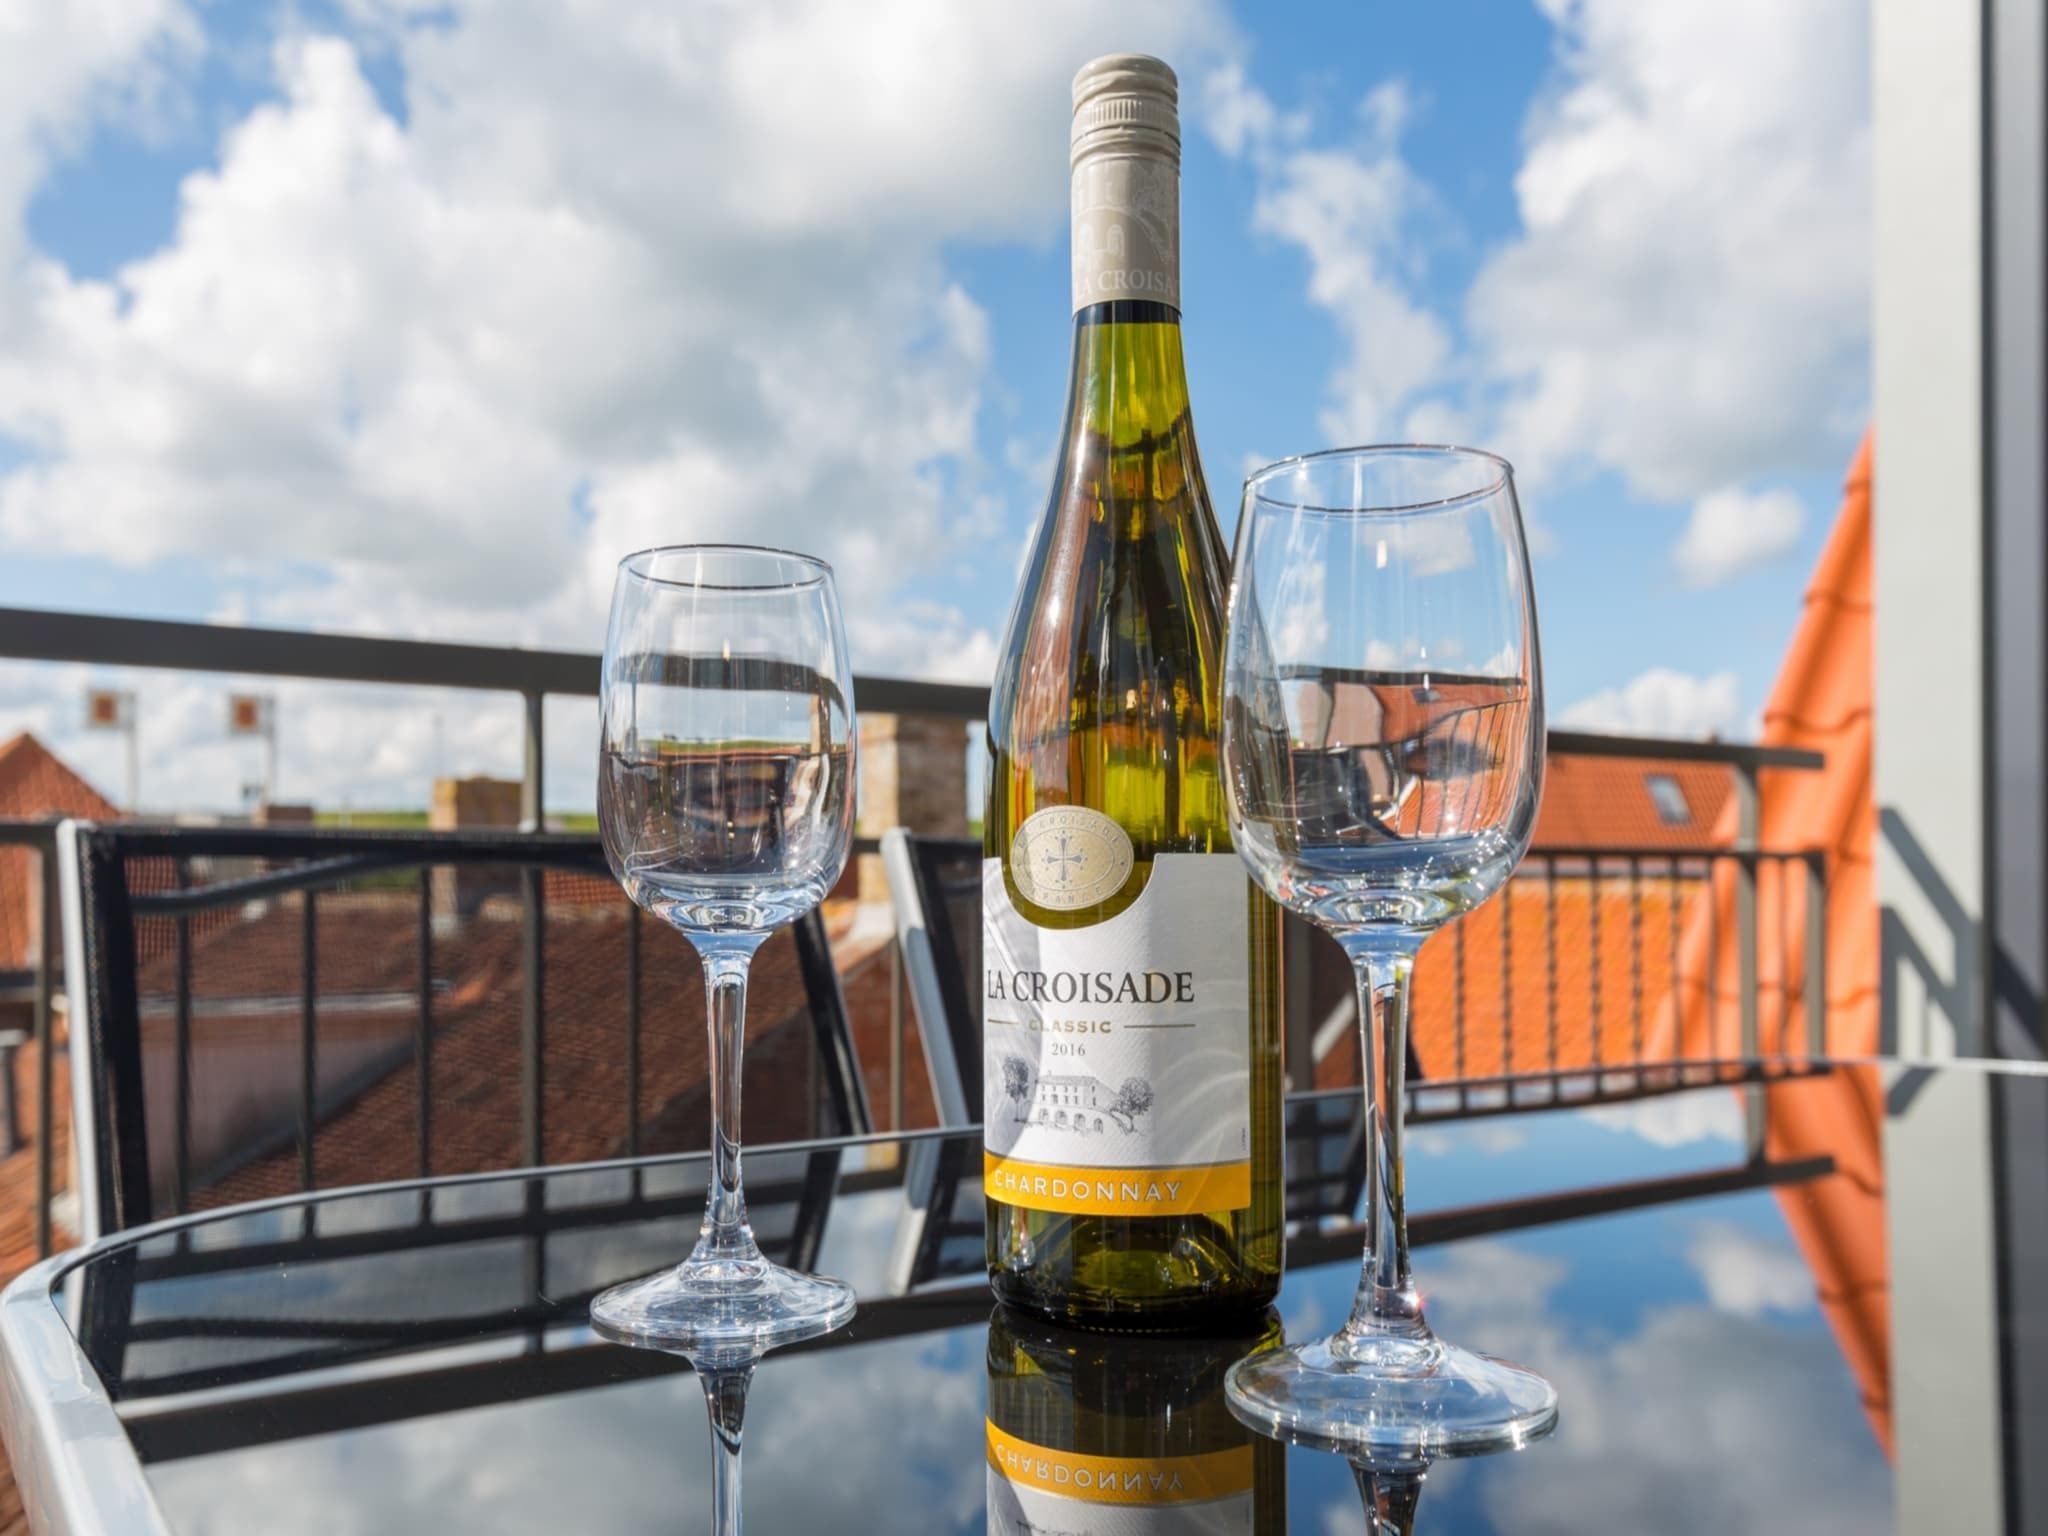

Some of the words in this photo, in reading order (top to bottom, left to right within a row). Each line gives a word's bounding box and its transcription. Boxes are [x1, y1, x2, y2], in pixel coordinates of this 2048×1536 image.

[987, 970, 1006, 999] LA
[1012, 971, 1195, 1003] CROISADE
[1028, 1019, 1112, 1034] CLASSIC
[1051, 1043, 1086, 1056] 2016
[995, 1170, 1182, 1201] CHARDONNAY
